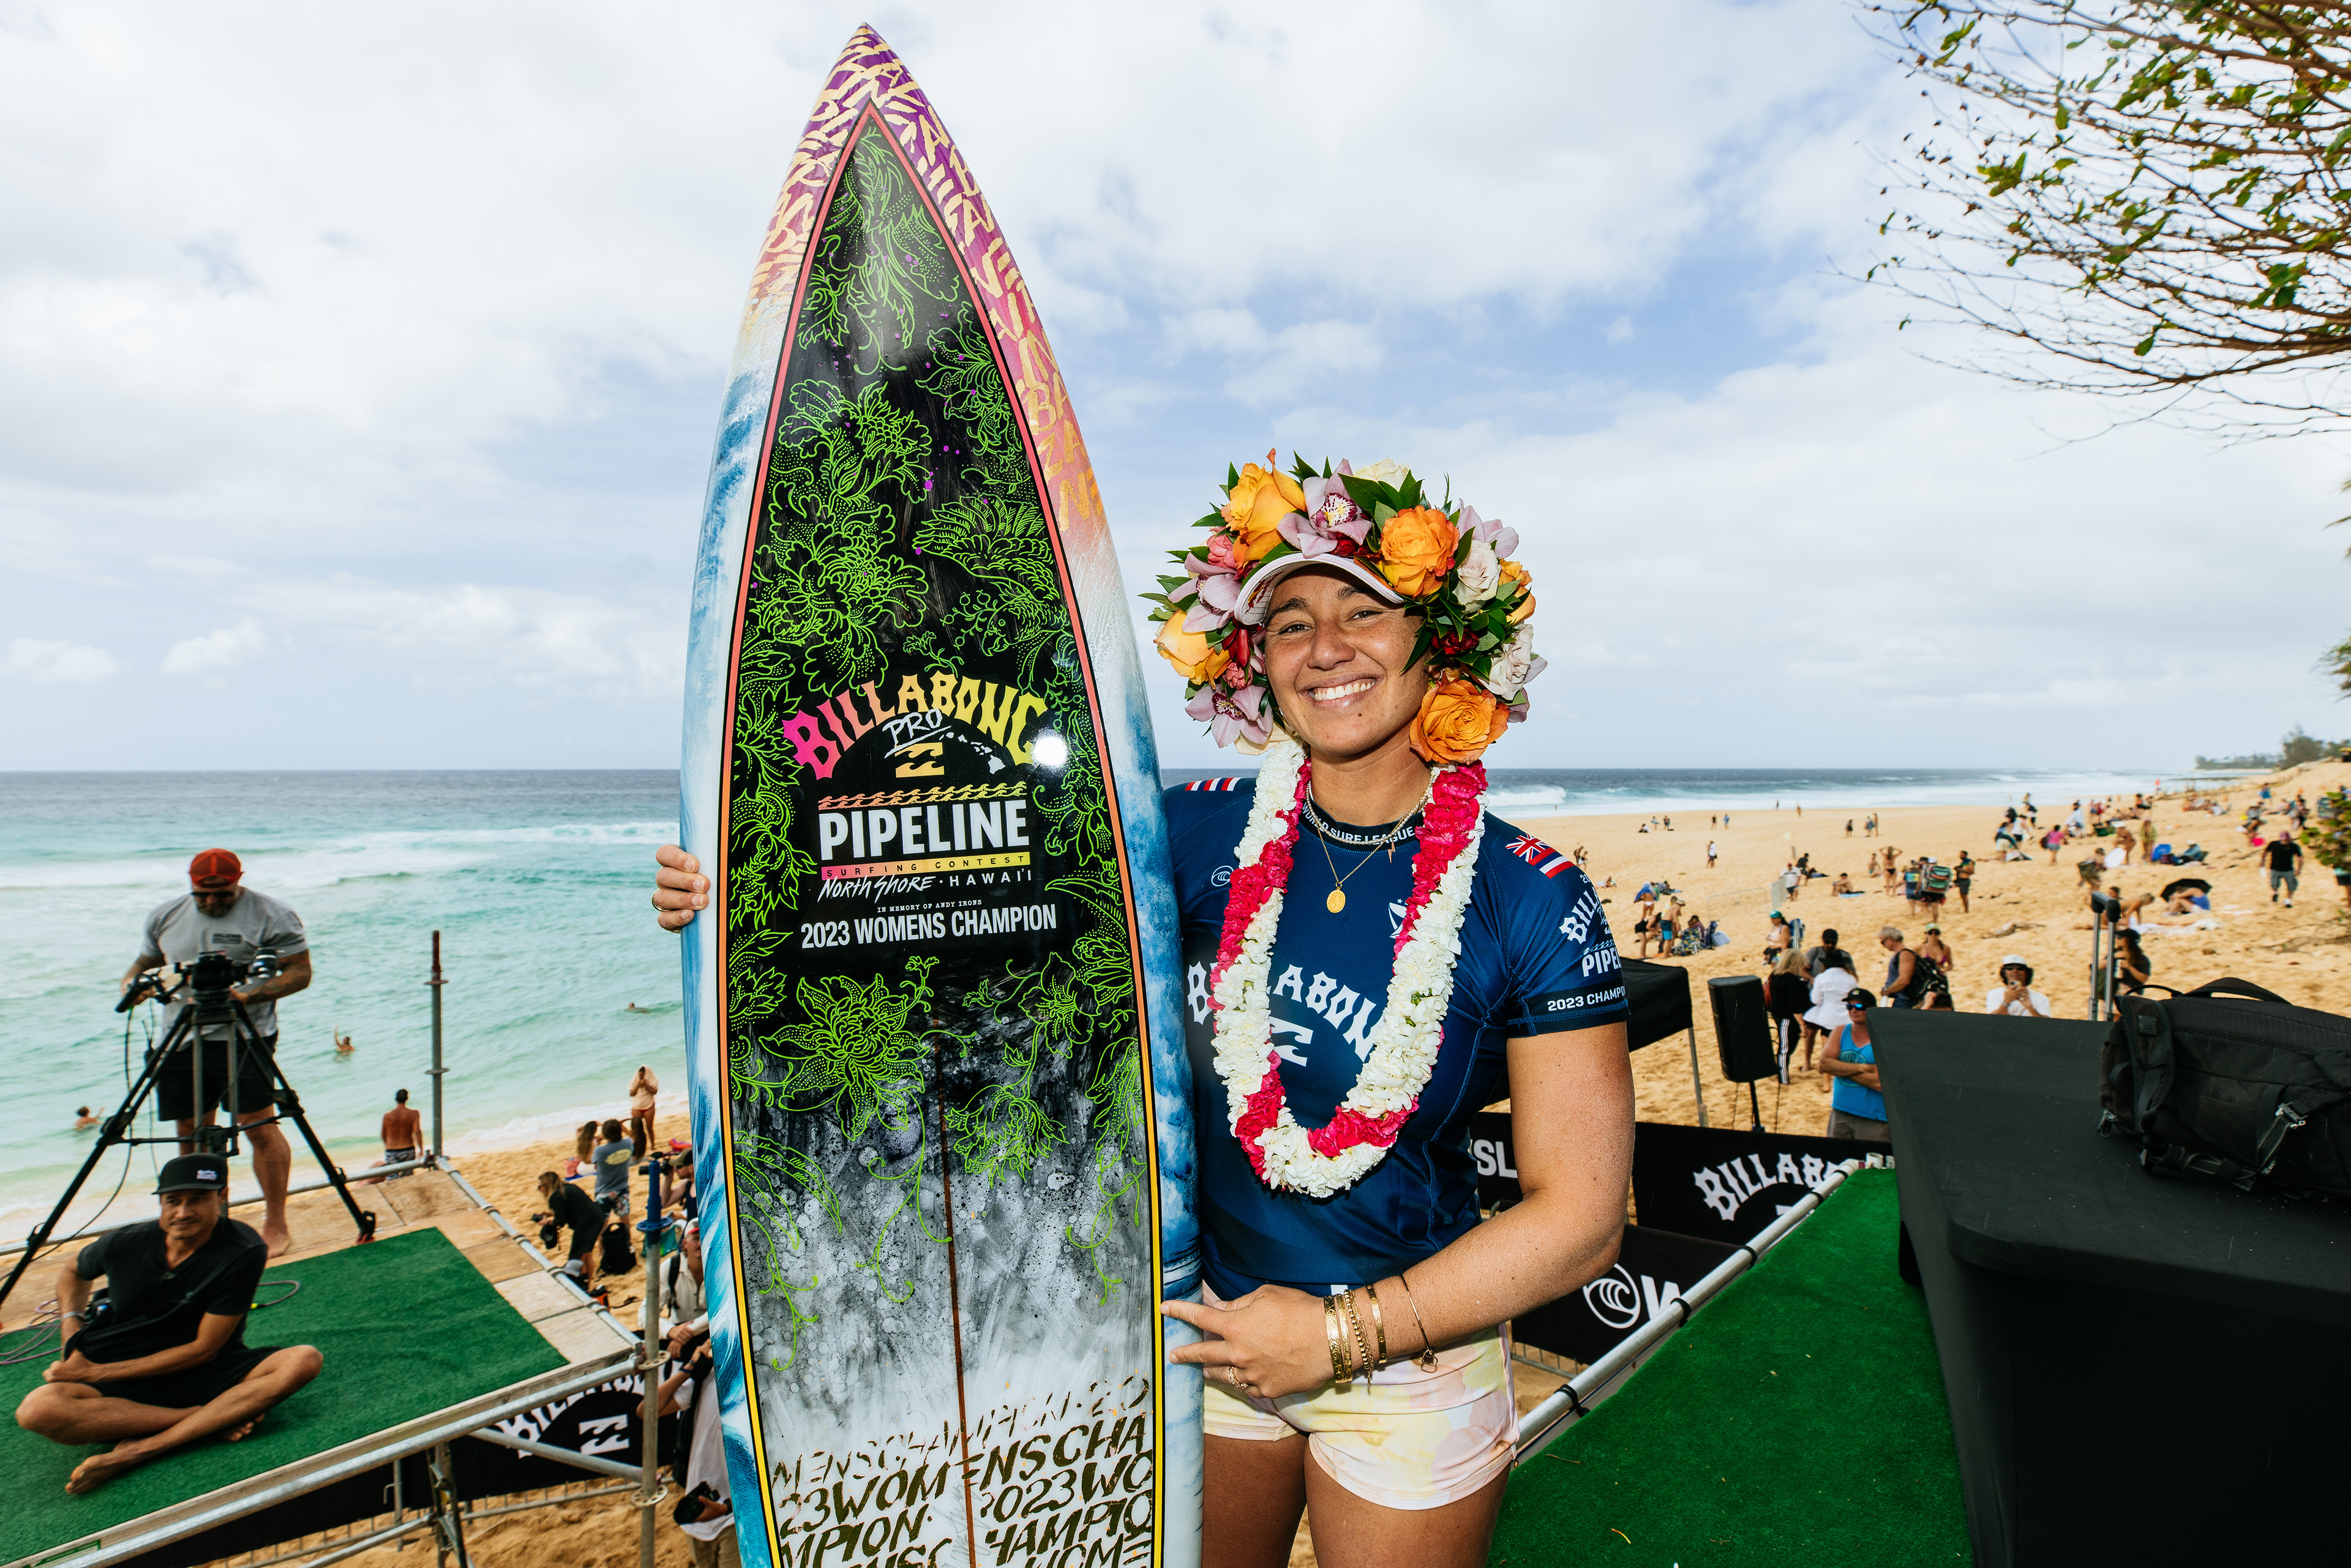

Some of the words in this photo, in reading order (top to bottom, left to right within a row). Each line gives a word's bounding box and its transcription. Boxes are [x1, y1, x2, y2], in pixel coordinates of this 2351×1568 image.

[782, 670, 1048, 780] BILLABONG
[882, 708, 943, 747] PRO
[819, 800, 1029, 860] PIPELINE
[827, 863, 917, 877] SURFING
[935, 855, 1024, 869] CONTEST
[801, 920, 850, 949] 2023
[854, 912, 947, 945] WOMENS
[951, 904, 1057, 937] CHAMPION
[1547, 996, 1584, 1011] 2023
[1474, 1139, 1518, 1179] SL
